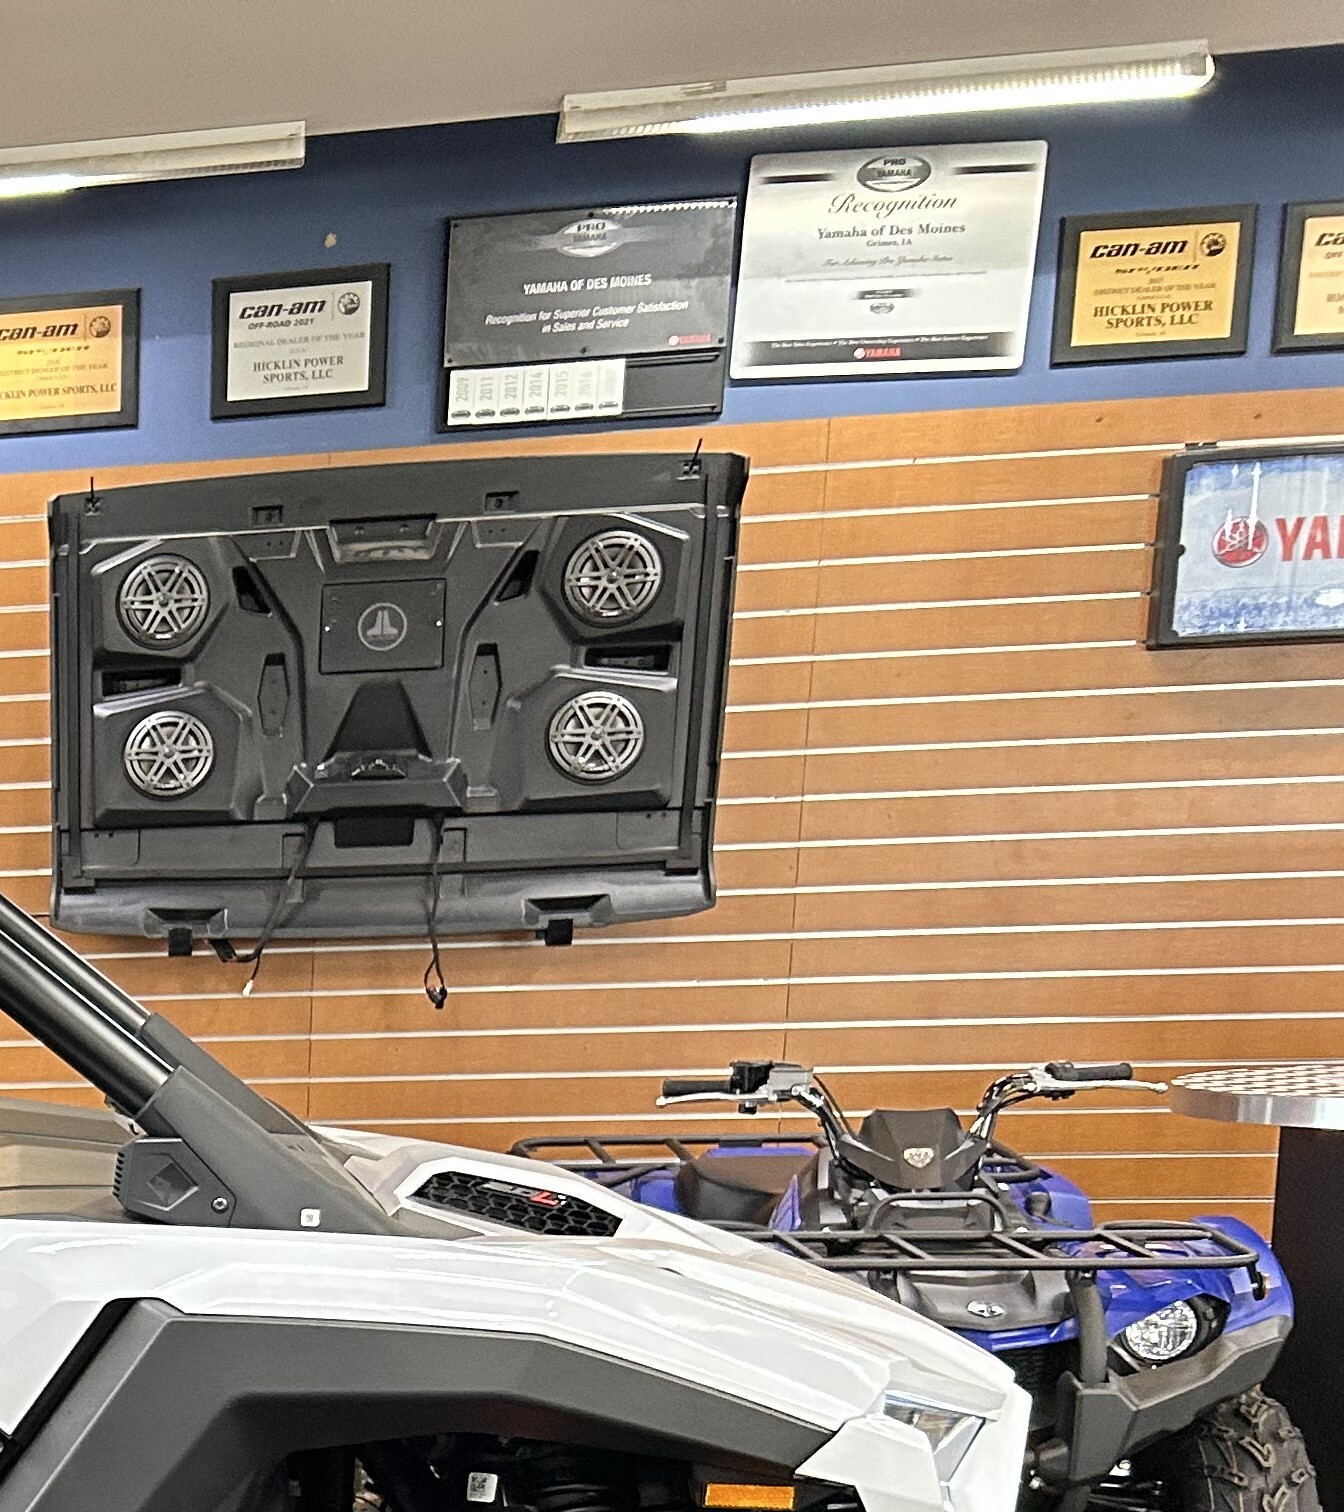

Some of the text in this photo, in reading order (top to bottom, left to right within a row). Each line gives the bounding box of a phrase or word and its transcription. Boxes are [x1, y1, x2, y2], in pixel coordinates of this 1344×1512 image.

[883, 157, 906, 166] PRO
[827, 191, 958, 219] Recognition
[577, 221, 606, 232] PRO
[817, 222, 966, 240] Yamaha of Des Moines
[1090, 239, 1189, 259] can-am
[523, 274, 652, 295] YAMAHA OF DES MOINES
[239, 300, 327, 319] can-am
[485, 300, 689, 326] Recognition for Superior Customer Satisfaction
[1093, 300, 1214, 318] HICKLIN POWER
[248, 319, 292, 330] OFF-ROAD
[541, 317, 629, 334] in Sales and Service
[1105, 313, 1200, 330] SPORTS, LLC
[253, 355, 344, 372] HICKLIN POWER
[263, 369, 333, 384] SPORTS, LLC
[529, 371, 543, 398] 2014
[555, 370, 569, 397] 2015
[28, 387, 60, 398] POWER
[62, 384, 98, 396] SPORTS,
[100, 382, 117, 393] LLC
[480, 376, 493, 401] 2011
[504, 373, 518, 400] 2012
